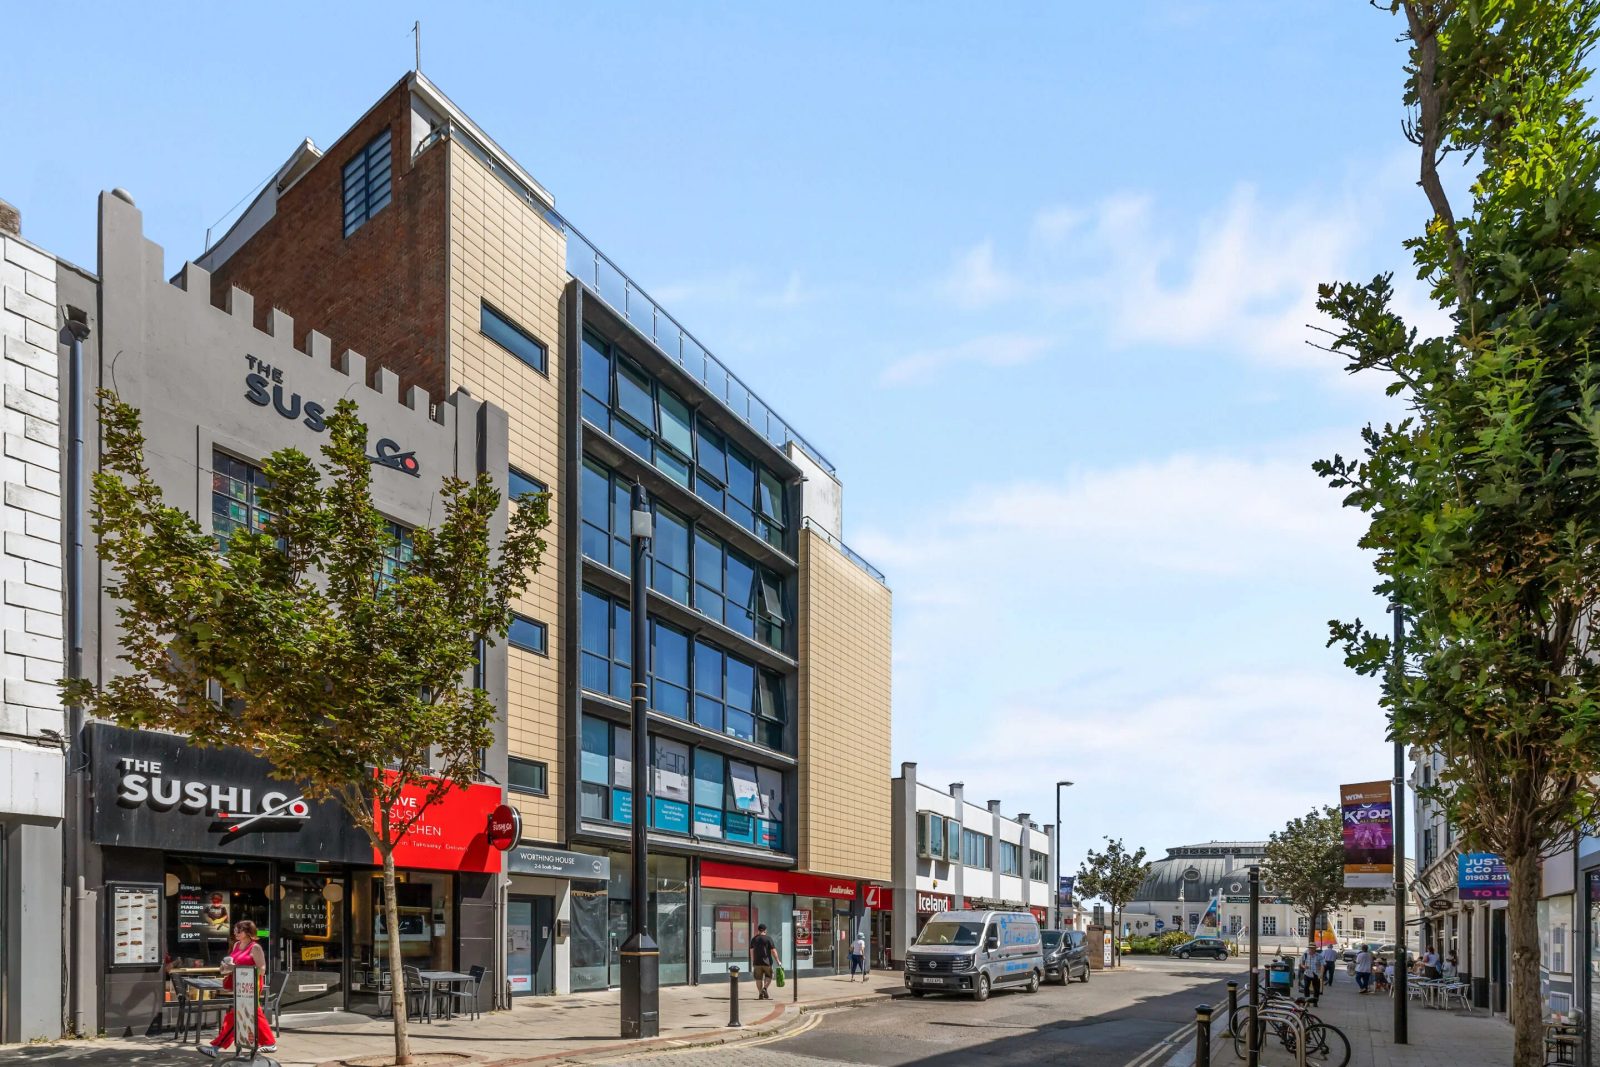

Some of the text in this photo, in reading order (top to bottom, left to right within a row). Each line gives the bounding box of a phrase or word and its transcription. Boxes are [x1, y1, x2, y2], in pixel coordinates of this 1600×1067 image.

[245, 354, 284, 385] THE
[121, 757, 162, 774] THE
[122, 774, 251, 813] SUSHI
[393, 796, 417, 808] IVE
[520, 853, 576, 865] WORTHING HOUSE
[829, 885, 855, 896] Ladbrokes
[918, 892, 949, 912] Iceland
